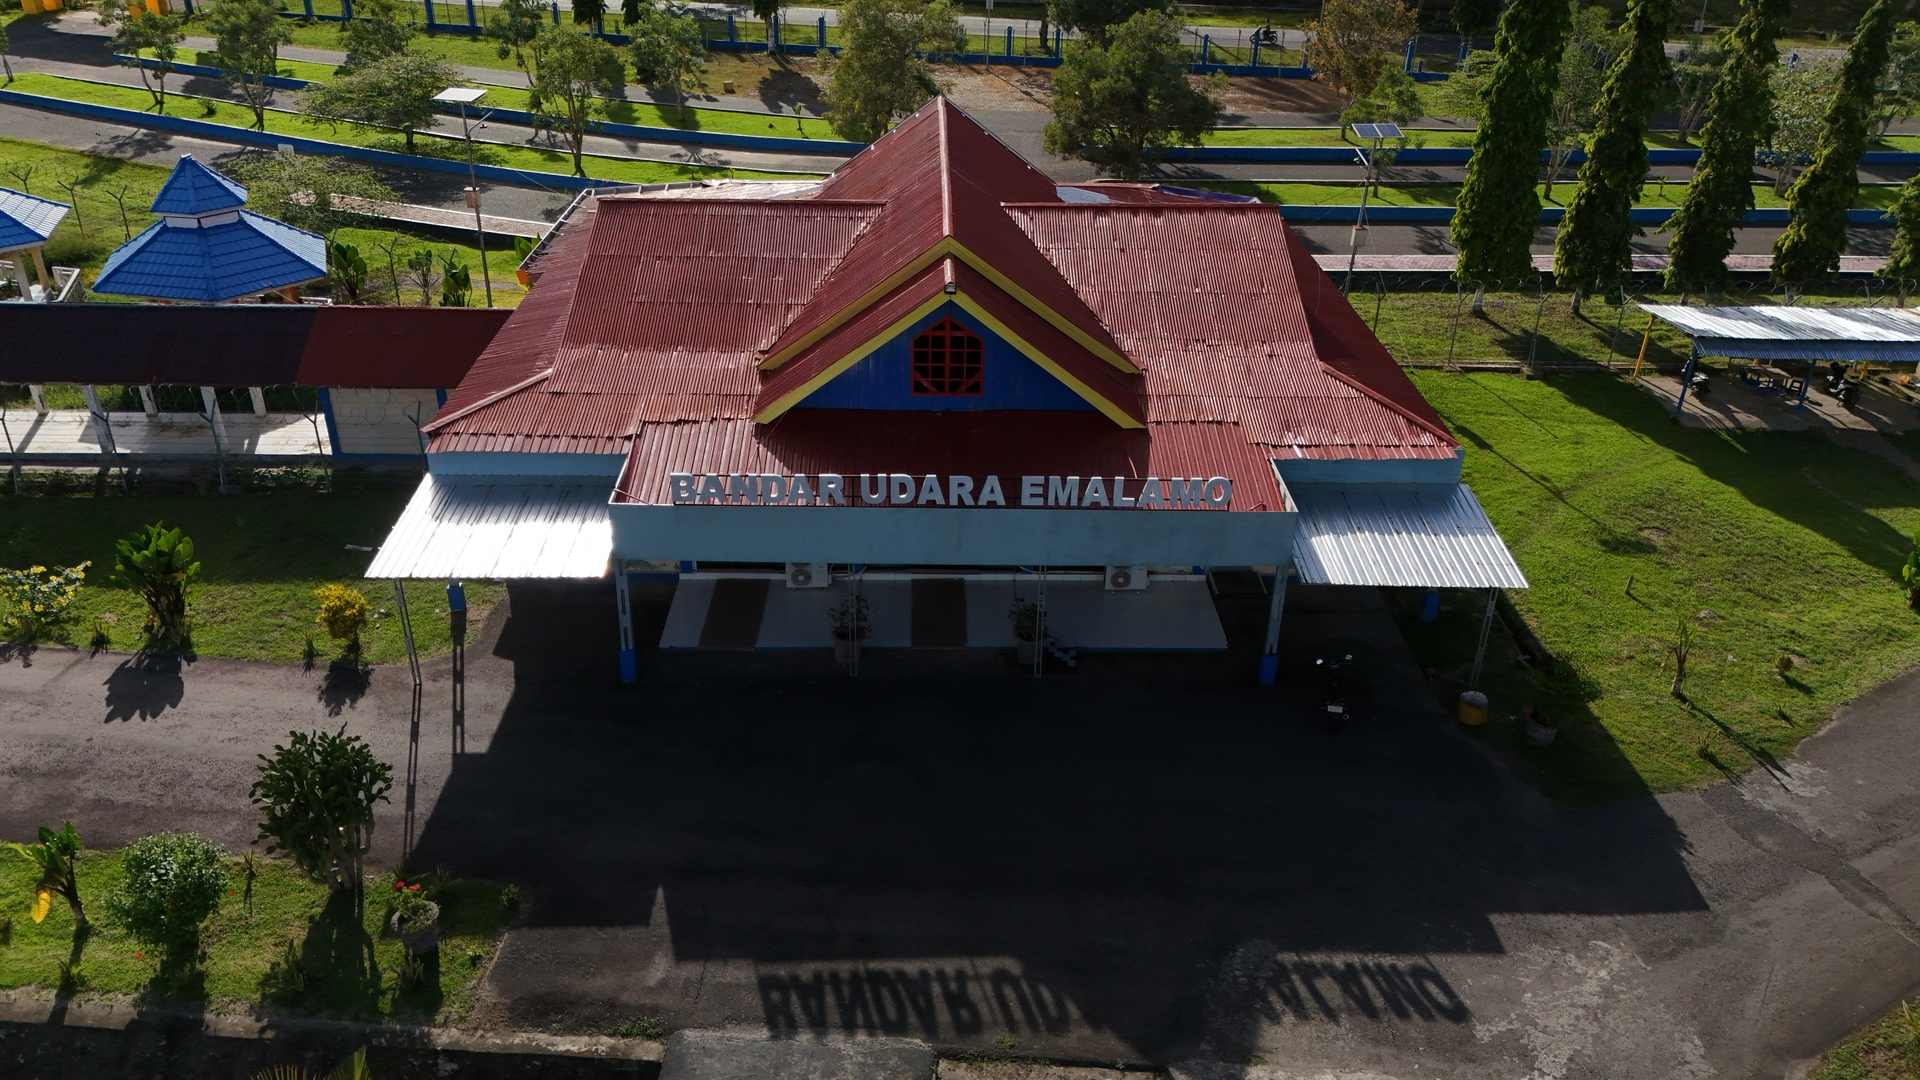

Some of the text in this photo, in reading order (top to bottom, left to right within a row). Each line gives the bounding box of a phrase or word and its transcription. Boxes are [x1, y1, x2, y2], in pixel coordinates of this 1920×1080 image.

[670, 472, 1233, 509] BANDAR UDARA EMALAMO
